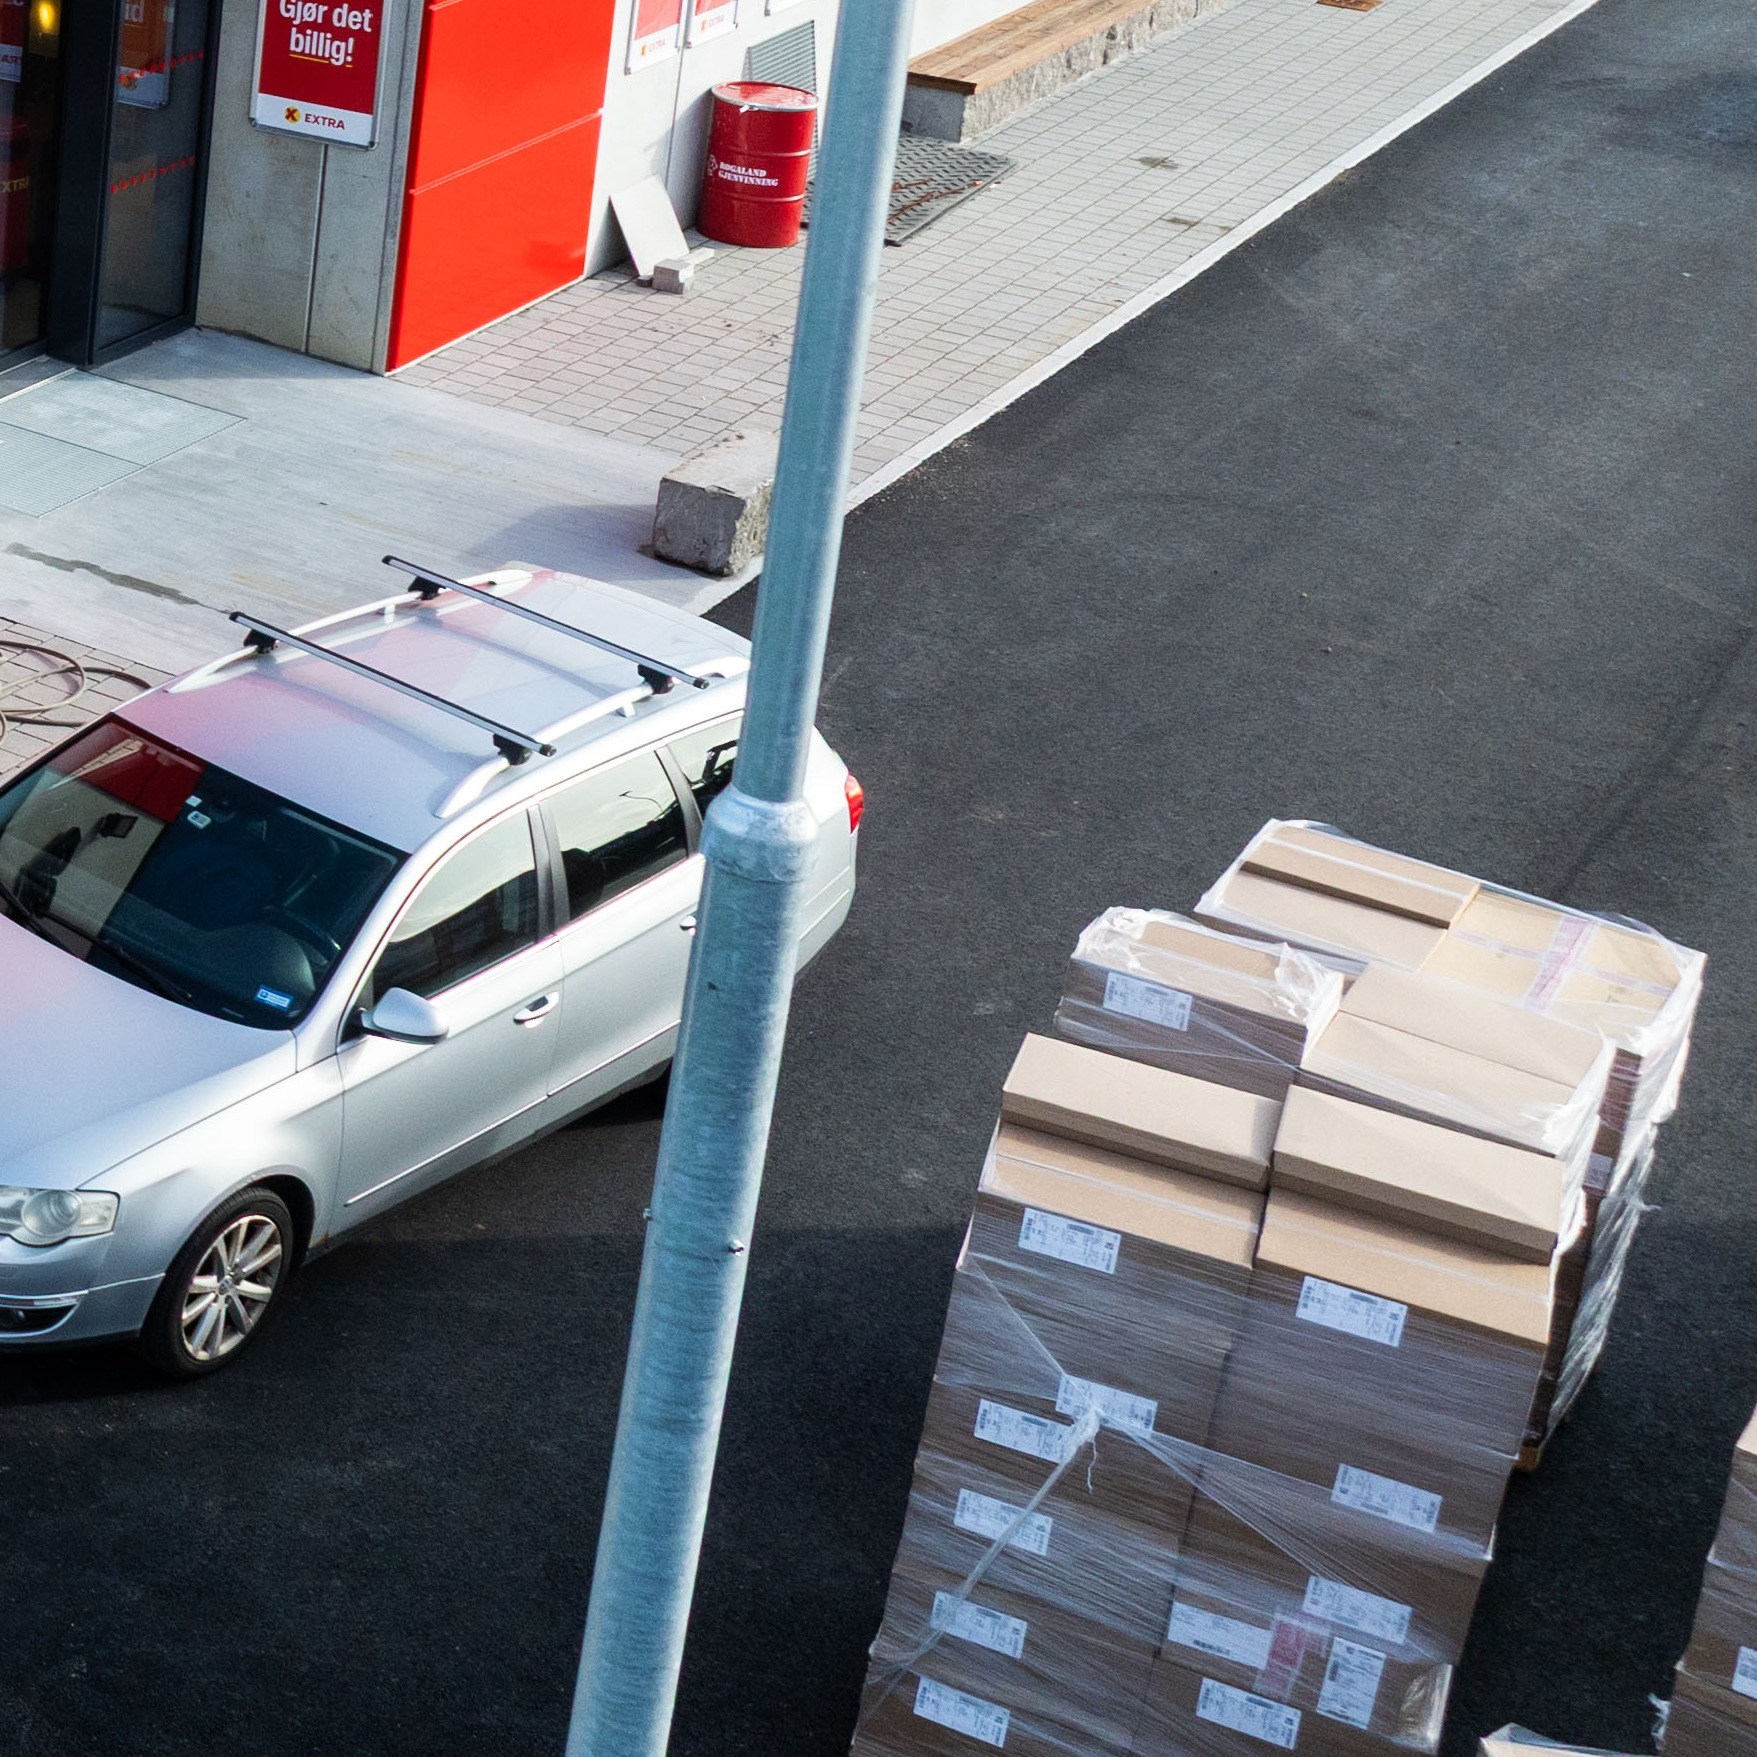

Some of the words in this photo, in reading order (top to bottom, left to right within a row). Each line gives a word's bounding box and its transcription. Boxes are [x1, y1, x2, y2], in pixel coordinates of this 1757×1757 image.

[332, 3, 373, 32] det
[289, 27, 354, 66] billig!
[304, 114, 346, 130] EXTRA
[719, 162, 767, 177] ROGALAND
[718, 170, 779, 186] GJENVINNING
